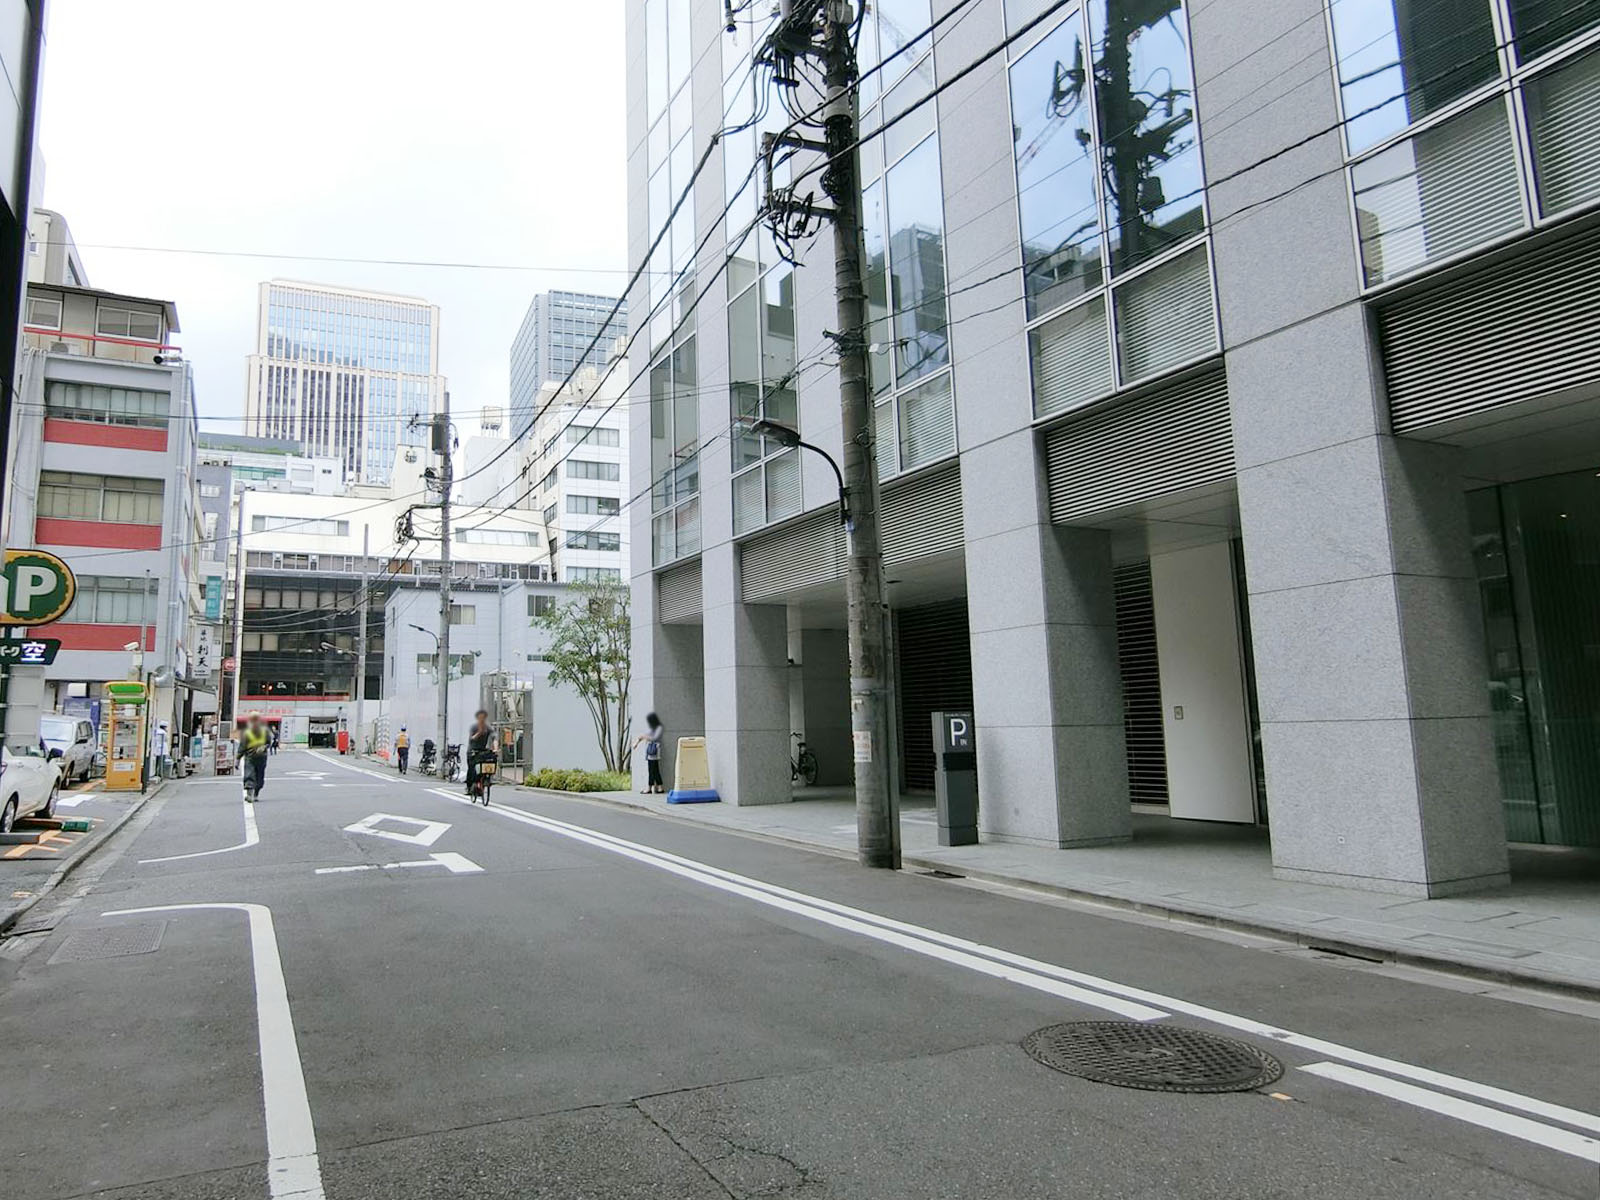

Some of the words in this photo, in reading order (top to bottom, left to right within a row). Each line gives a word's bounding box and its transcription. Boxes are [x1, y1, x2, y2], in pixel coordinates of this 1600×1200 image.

[14, 566, 57, 611] P
[20, 641, 46, 661] 空
[951, 718, 967, 746] P
